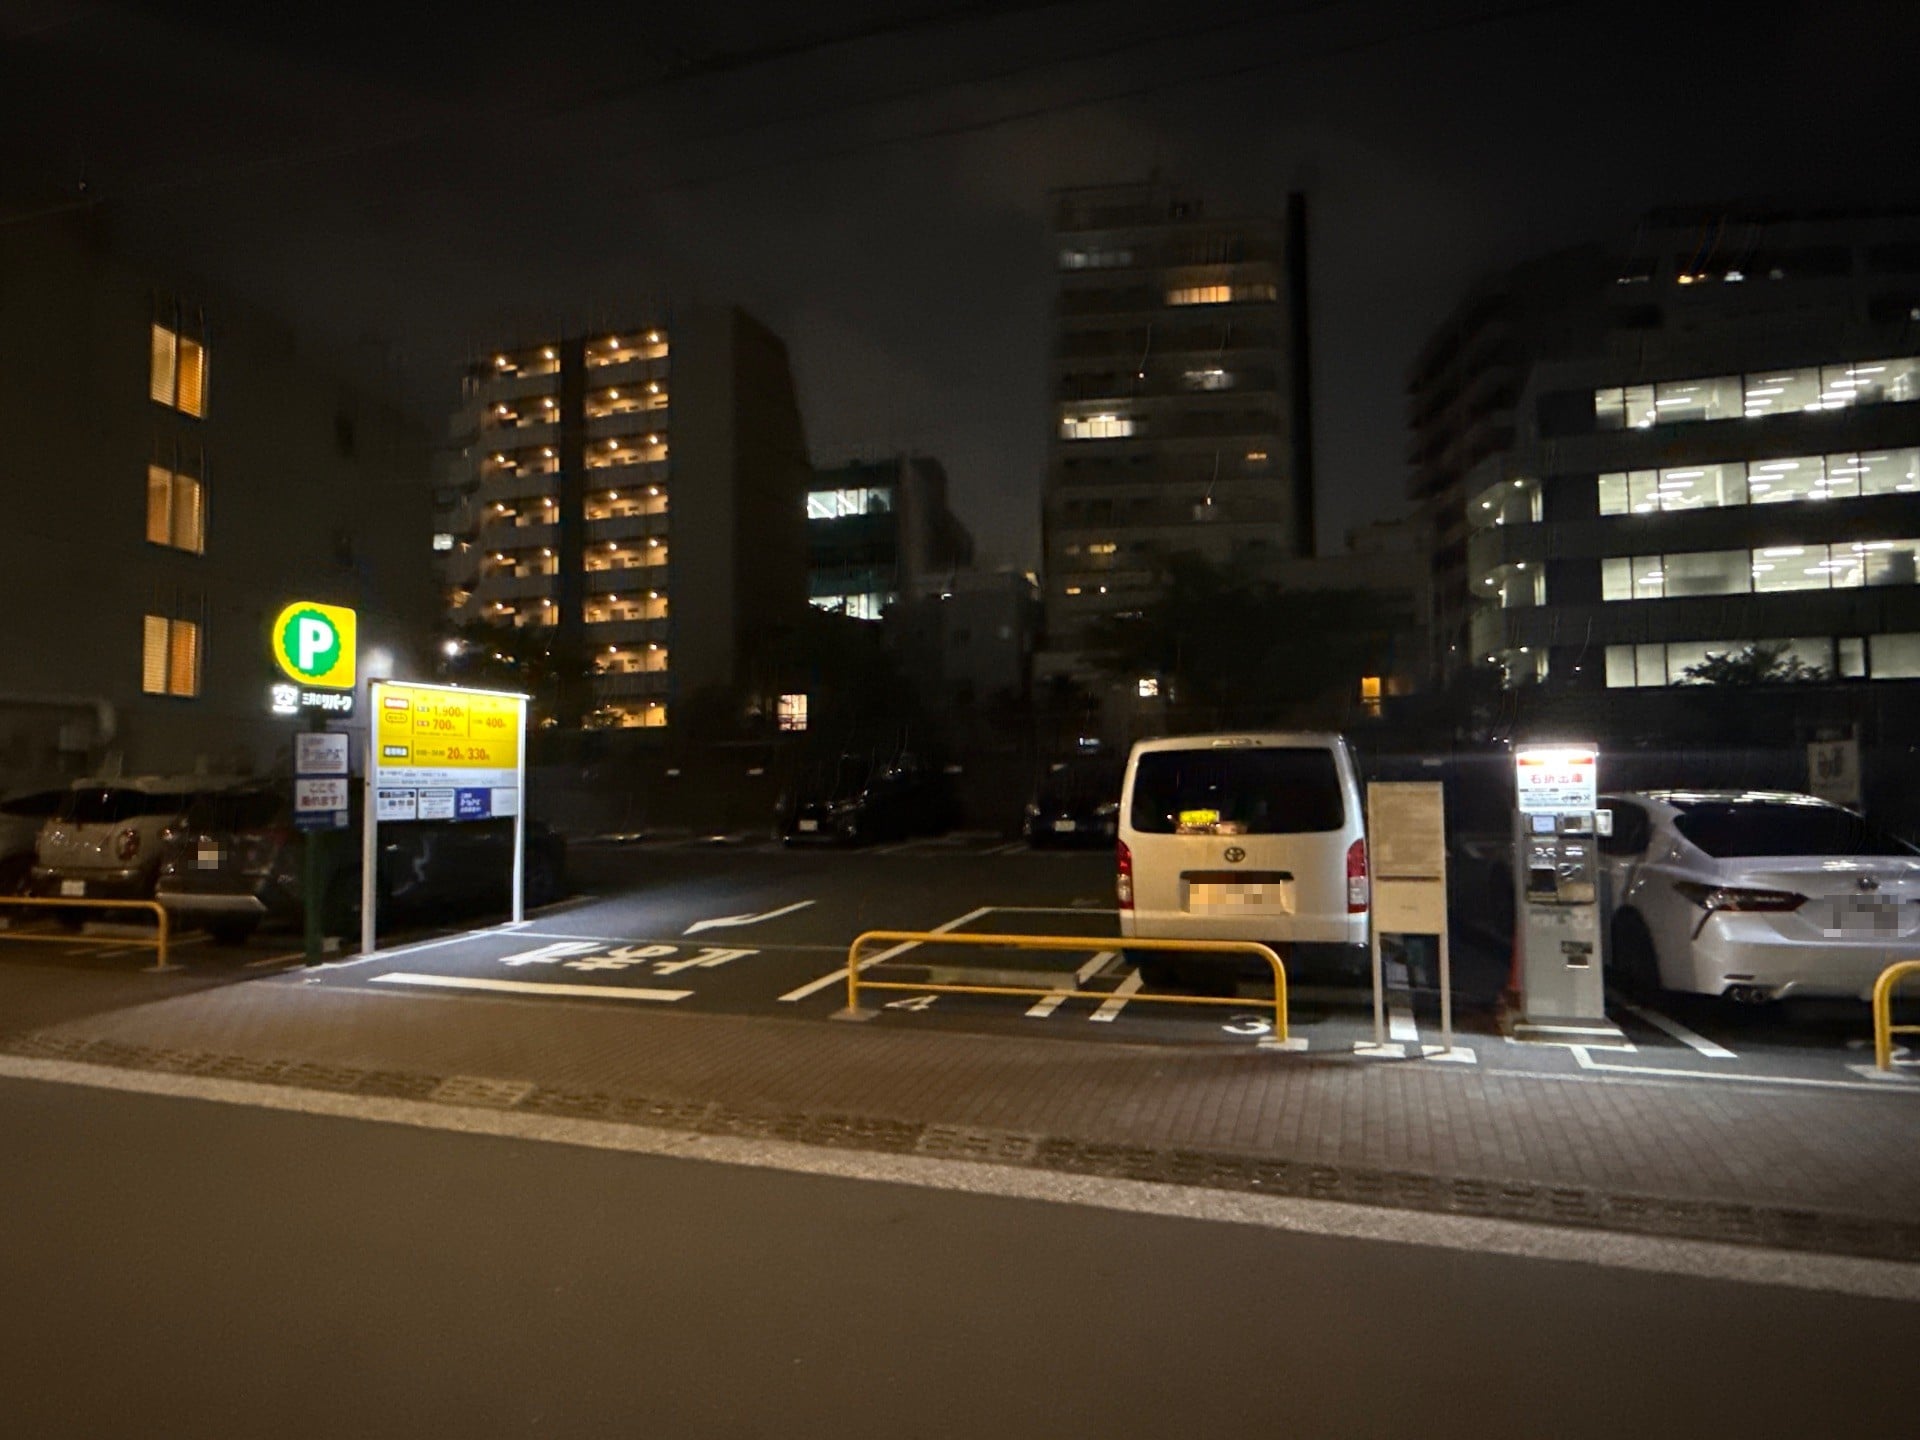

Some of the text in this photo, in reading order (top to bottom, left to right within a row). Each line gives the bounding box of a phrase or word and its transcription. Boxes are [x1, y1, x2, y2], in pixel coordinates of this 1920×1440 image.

[298, 618, 334, 670] P
[433, 706, 464, 717] 1,900
[433, 719, 456, 730] 700
[484, 717, 507, 729] 400
